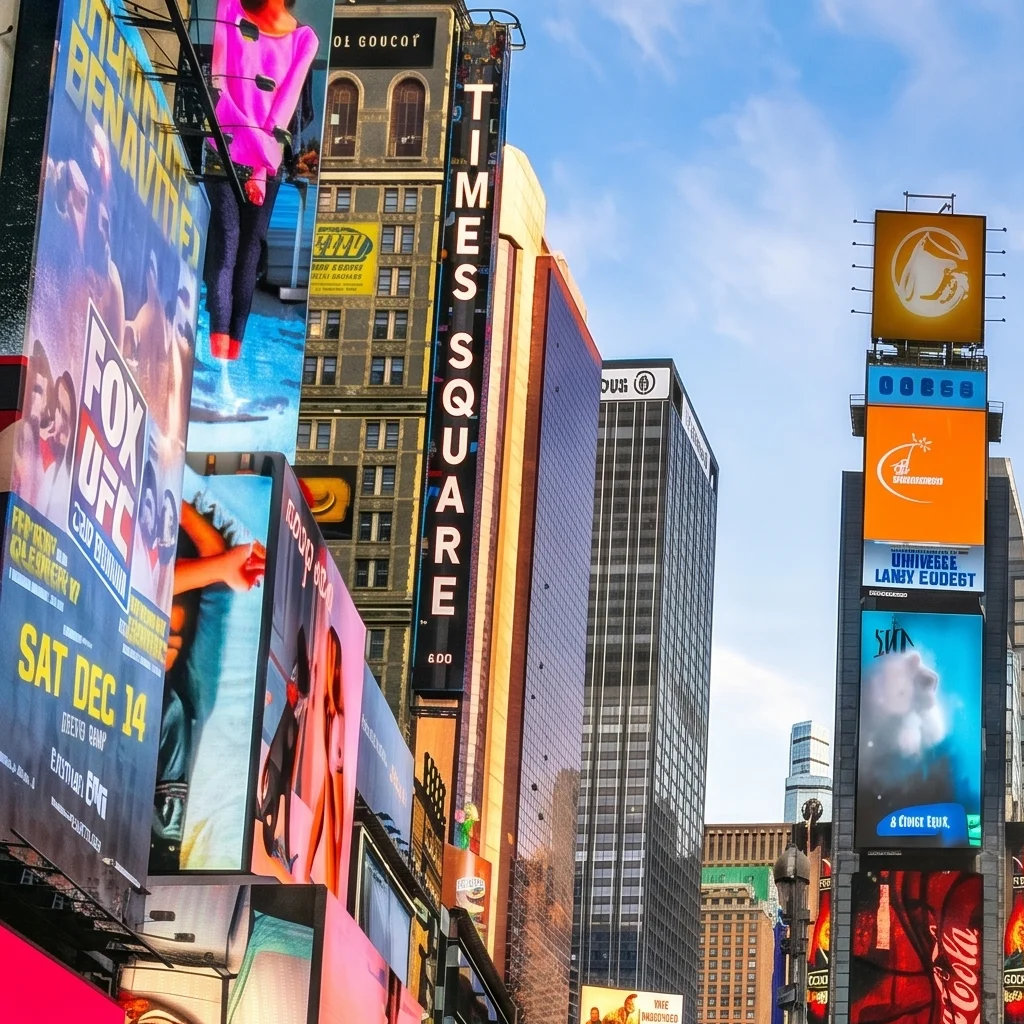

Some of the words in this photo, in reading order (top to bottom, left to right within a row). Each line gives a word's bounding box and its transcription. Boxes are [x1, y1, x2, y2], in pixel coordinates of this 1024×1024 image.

[452, 84, 495, 301] TIMES
[83, 316, 144, 488] FOX
[432, 331, 474, 616] SQUARE
[18, 623, 69, 698] SAT
[72, 654, 117, 728] DEC
[122, 683, 148, 743] 14
